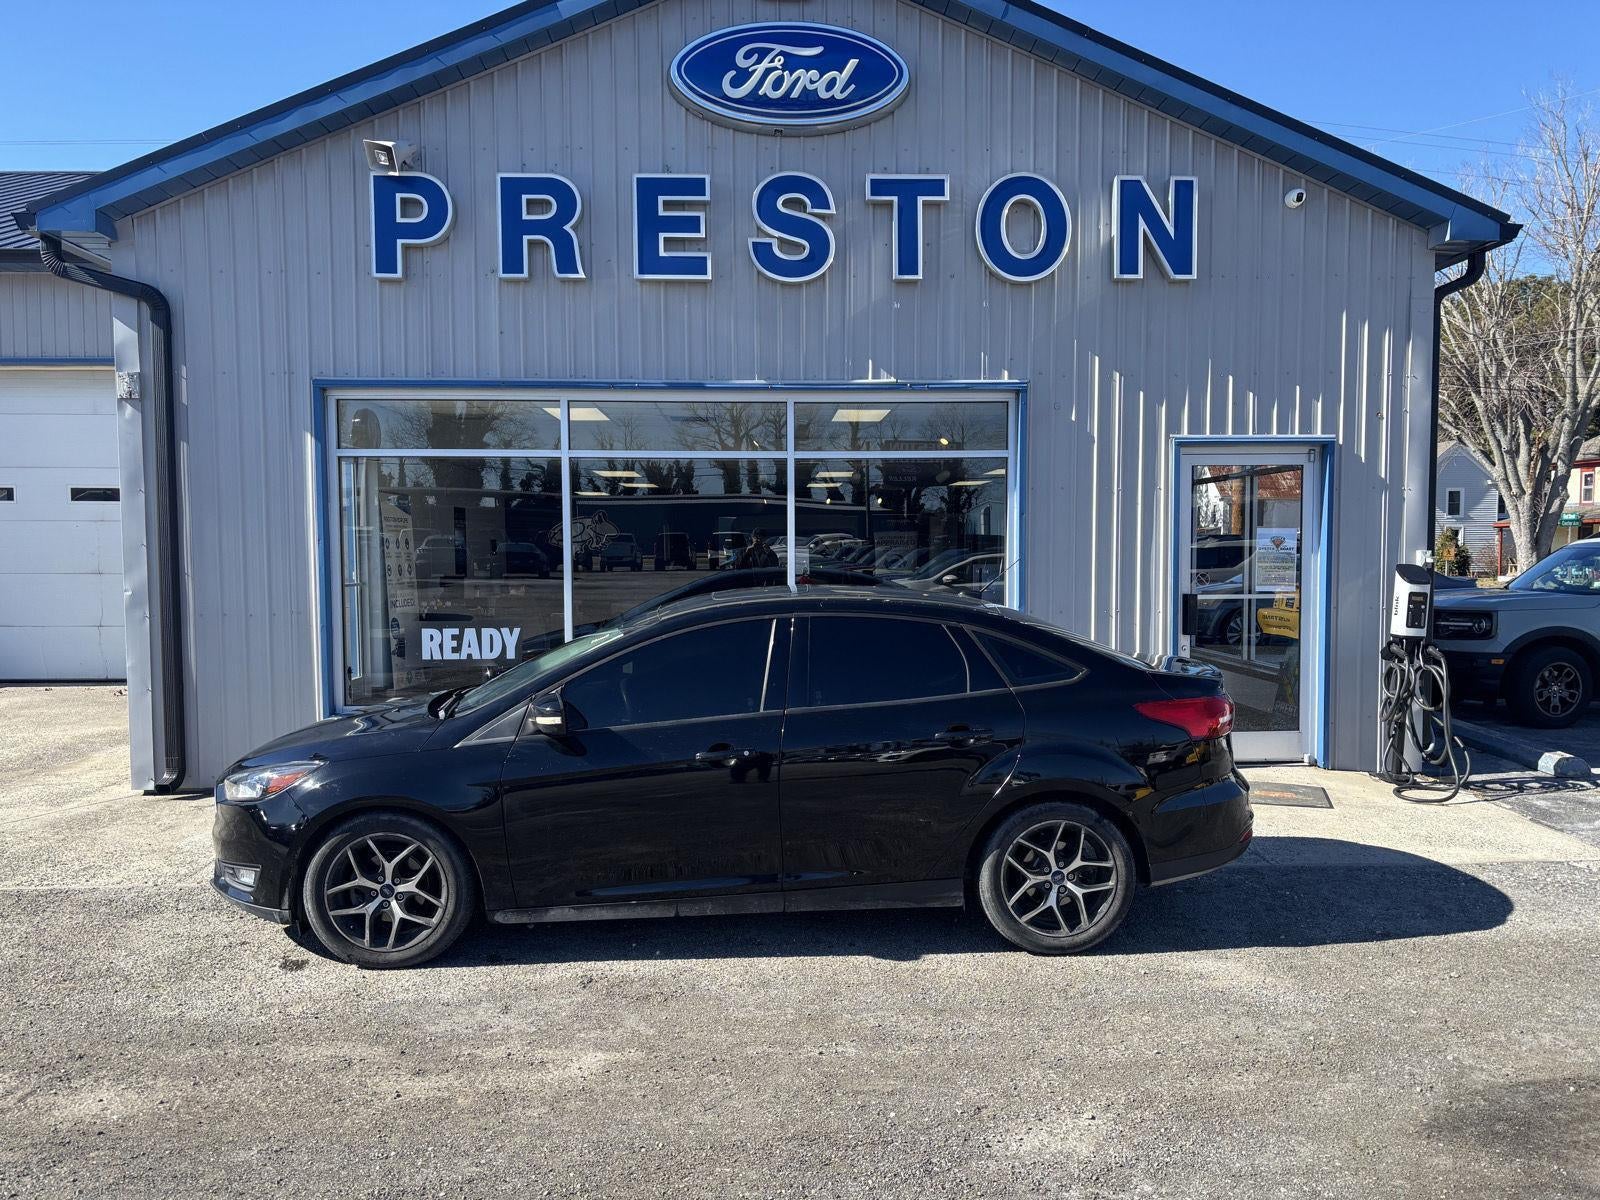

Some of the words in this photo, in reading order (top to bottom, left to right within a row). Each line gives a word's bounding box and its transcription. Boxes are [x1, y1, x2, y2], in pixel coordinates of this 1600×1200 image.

[722, 43, 859, 101] Ford
[370, 171, 1199, 283] PRESTON
[421, 628, 520, 659] READY
